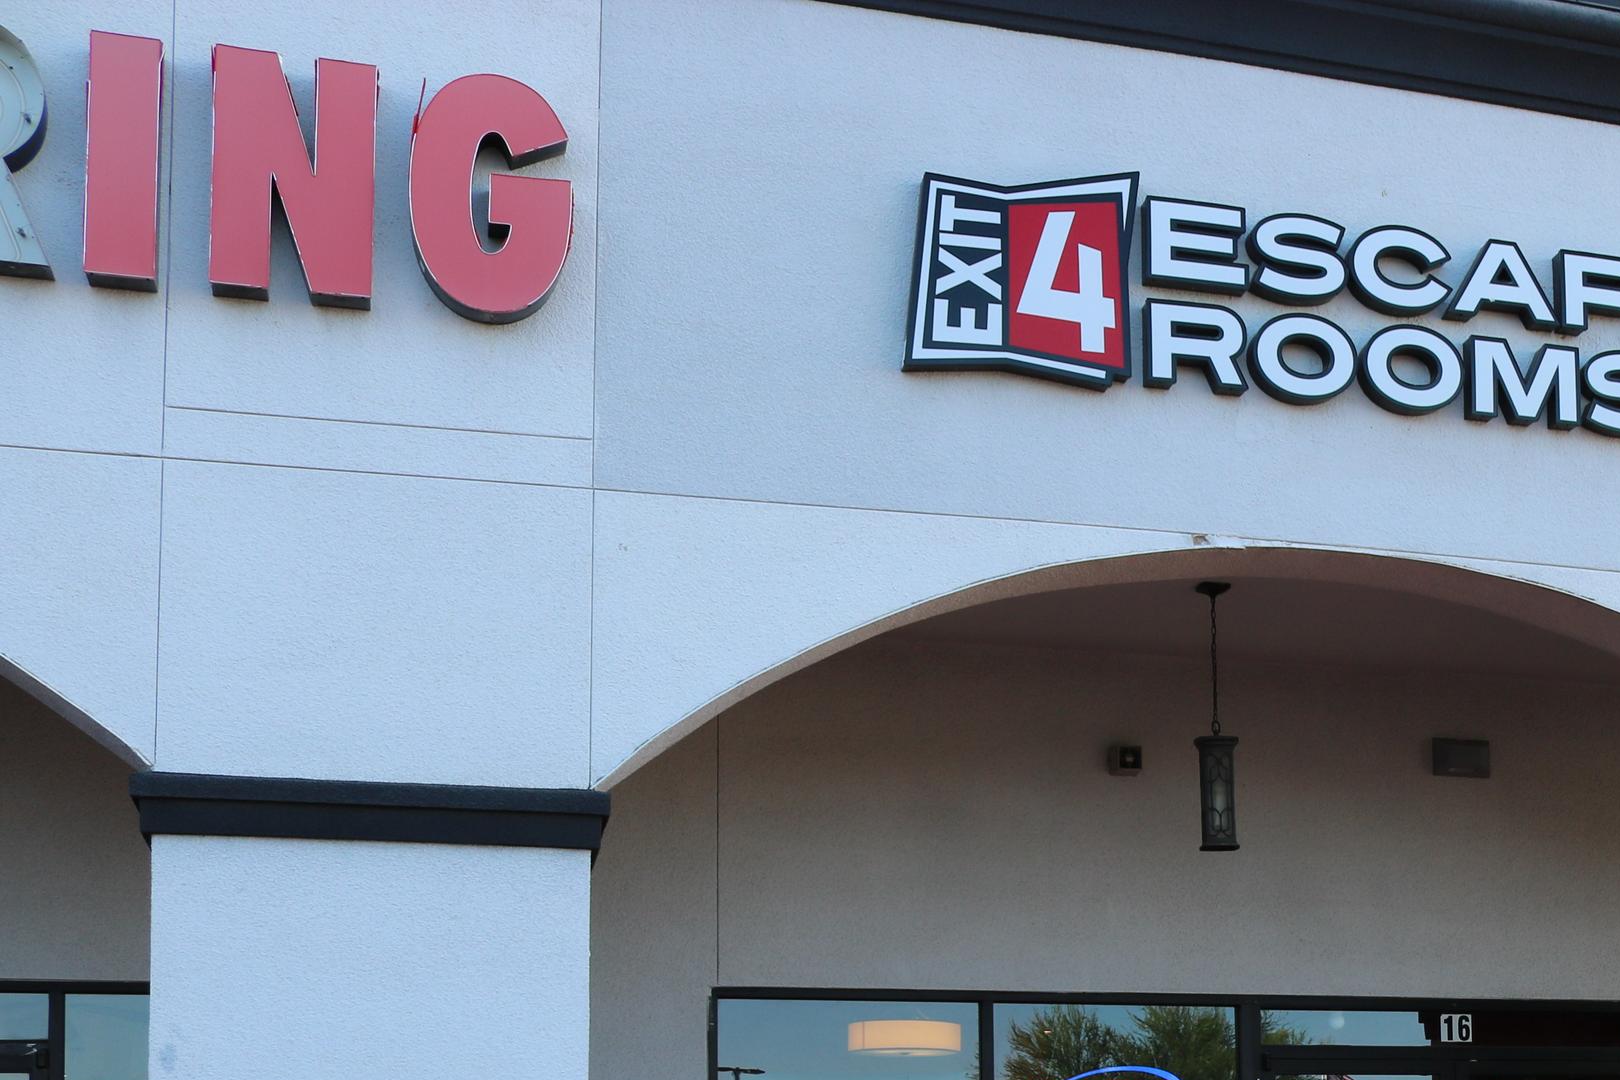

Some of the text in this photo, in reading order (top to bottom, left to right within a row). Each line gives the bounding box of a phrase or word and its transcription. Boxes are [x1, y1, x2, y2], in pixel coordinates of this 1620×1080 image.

[933, 194, 1116, 354] EXIT 4
[1444, 1015, 1471, 1042] 16
